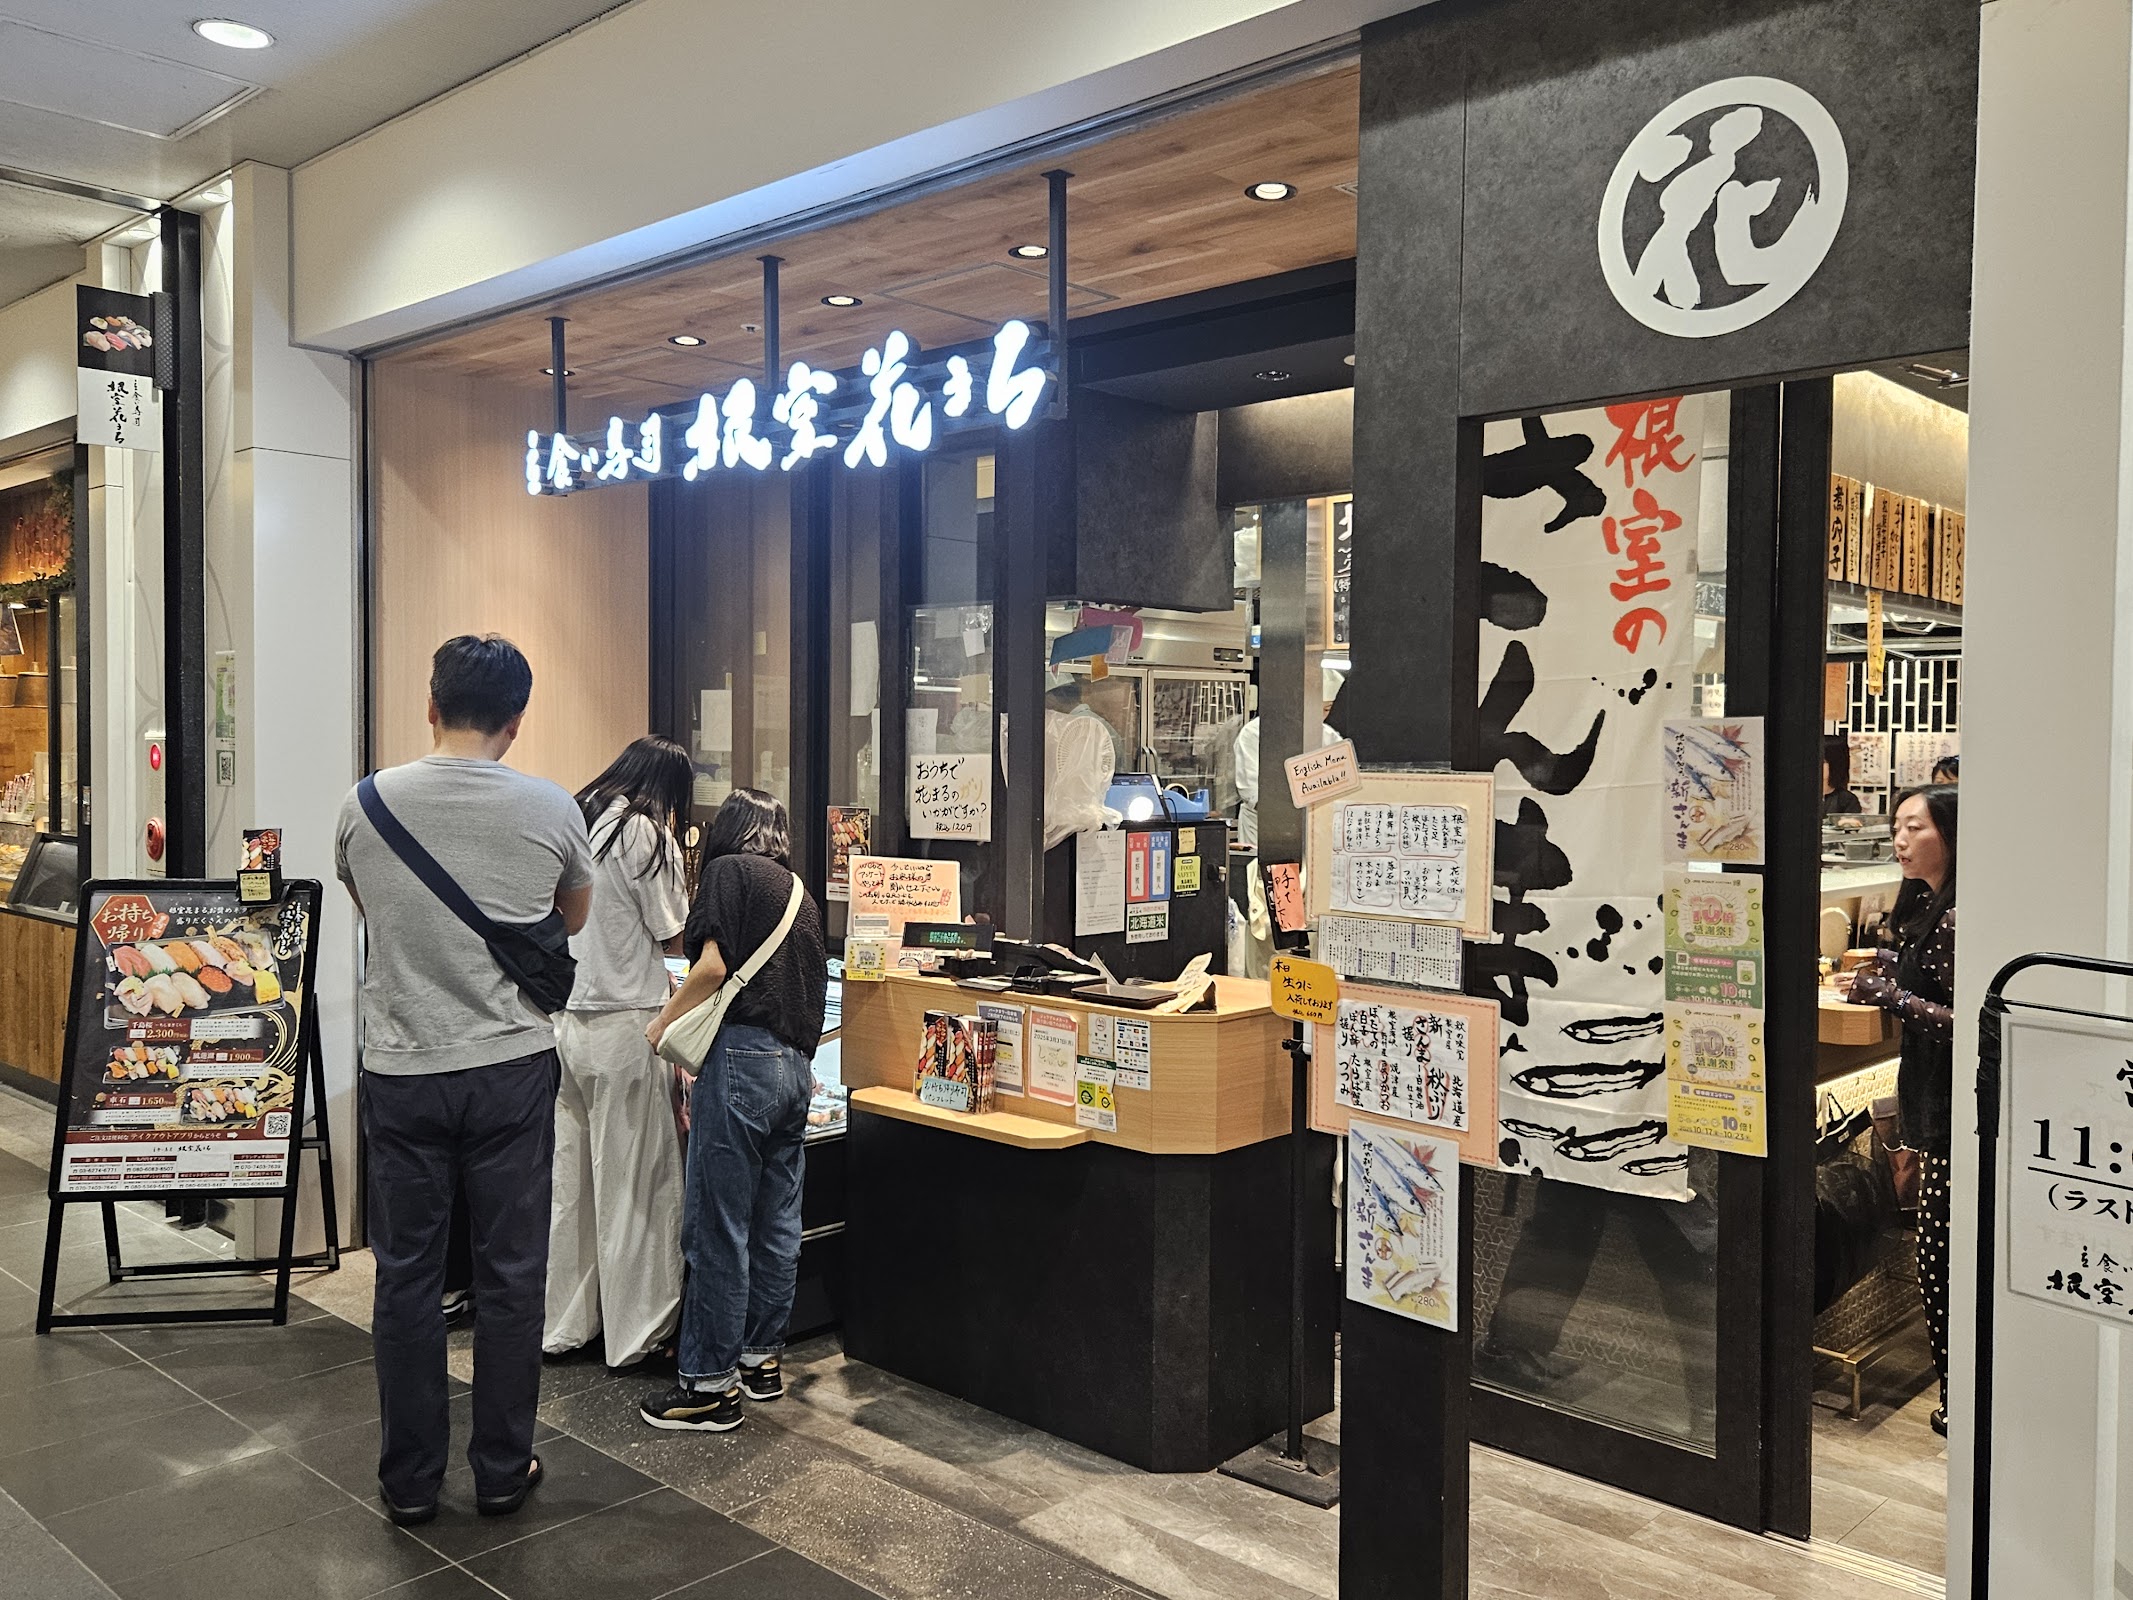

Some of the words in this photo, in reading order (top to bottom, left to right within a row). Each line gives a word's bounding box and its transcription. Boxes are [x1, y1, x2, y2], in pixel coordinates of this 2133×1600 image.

[107, 380, 129, 444] 根室花まる
[682, 319, 1047, 483] 根室花まる
[1602, 395, 1696, 655] 根室の
[916, 757, 965, 780] おうちで
[1293, 760, 1322, 777] English
[1451, 814, 1465, 837] 根室
[102, 903, 154, 924] お持ち
[1130, 914, 1164, 930] 北海道米
[107, 924, 145, 942] 帰り
[1273, 959, 1290, 972] 本日
[1282, 976, 1312, 991] 生うに
[1415, 1016, 1431, 1062] さんま
[1428, 1013, 1443, 1037] 新
[1402, 1025, 1415, 1057] 握り
[1339, 1061, 1350, 1095] つつみ
[1452, 1074, 1466, 1128] 北海道産
[2033, 1119, 2133, 1175] 11:
[2046, 1270, 2133, 1315] 根室
